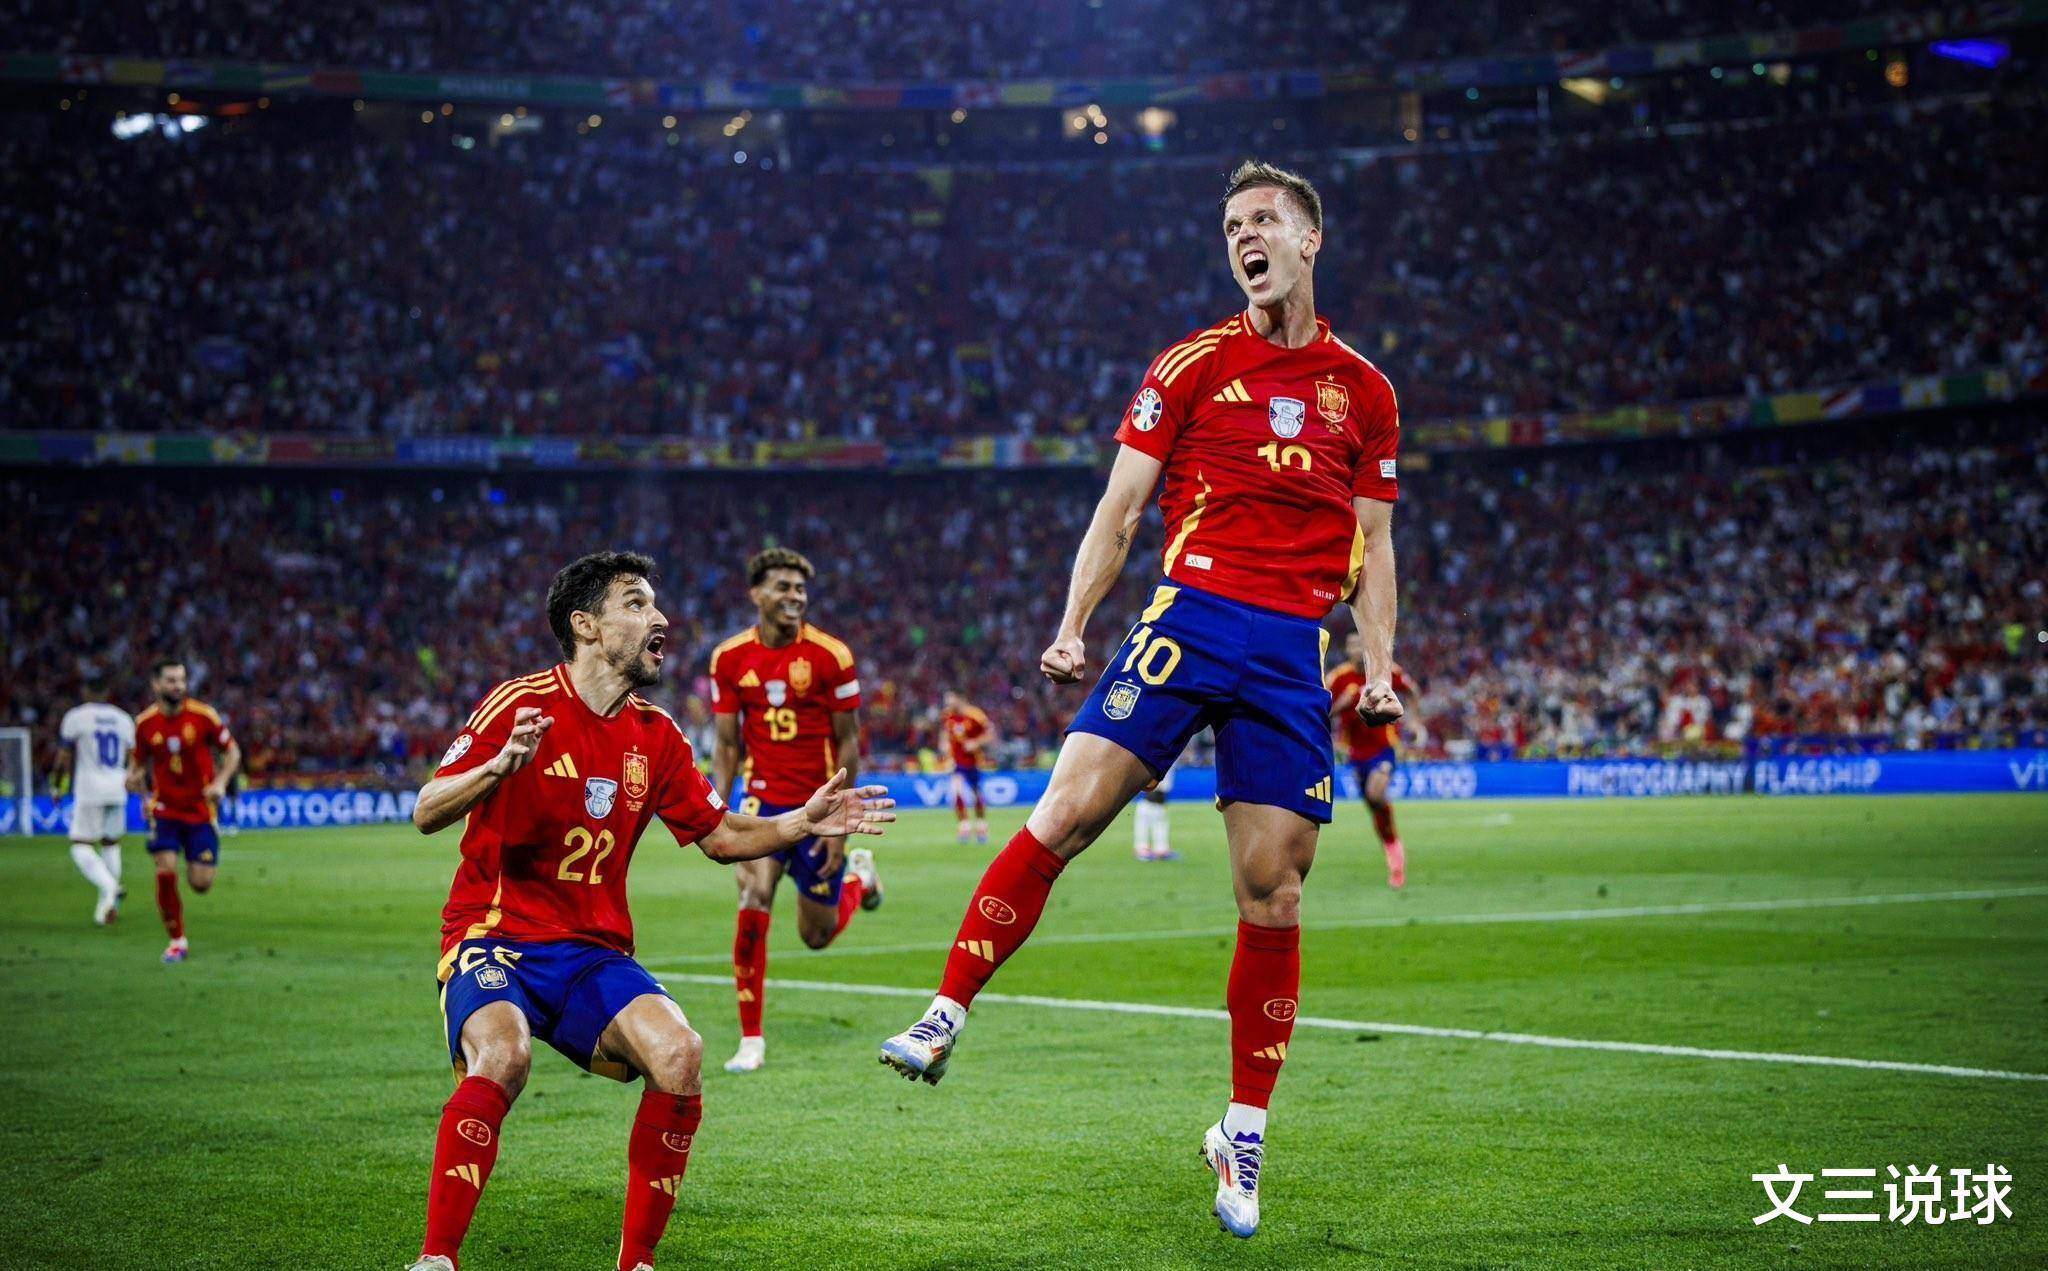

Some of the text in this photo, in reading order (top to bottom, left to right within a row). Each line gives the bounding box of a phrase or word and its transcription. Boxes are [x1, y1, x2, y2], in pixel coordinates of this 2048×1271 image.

[1122, 625, 1182, 685] 10
[763, 707, 798, 741] 19
[94, 730, 119, 767] 10
[1567, 758, 1882, 795] PHOTOGRAPHY FLAGSHIP
[557, 826, 616, 885] 22
